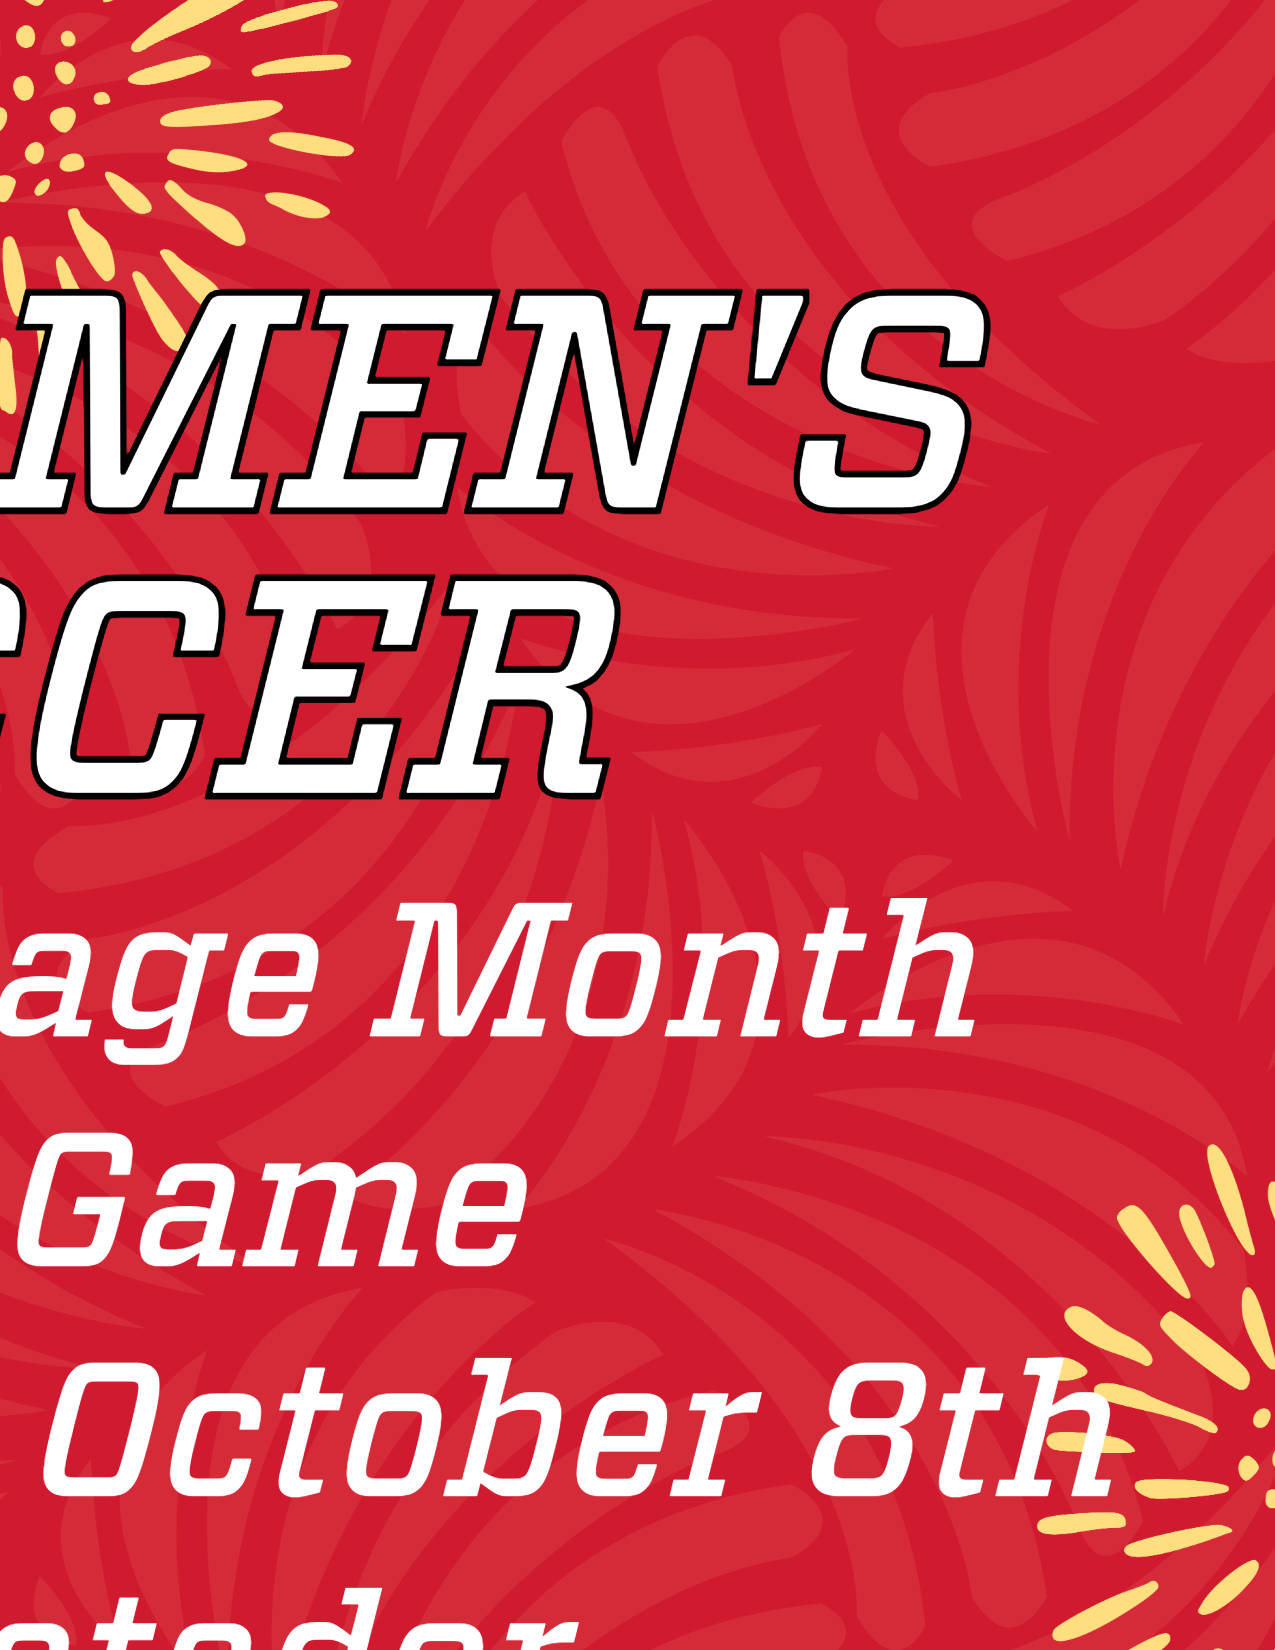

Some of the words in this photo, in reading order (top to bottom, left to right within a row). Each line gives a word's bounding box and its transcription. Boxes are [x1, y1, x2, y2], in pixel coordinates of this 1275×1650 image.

[370, 898, 974, 1037] Month
[18, 1133, 526, 1266] Game
[44, 1358, 761, 1497] October
[812, 1358, 1111, 1497] 8th
